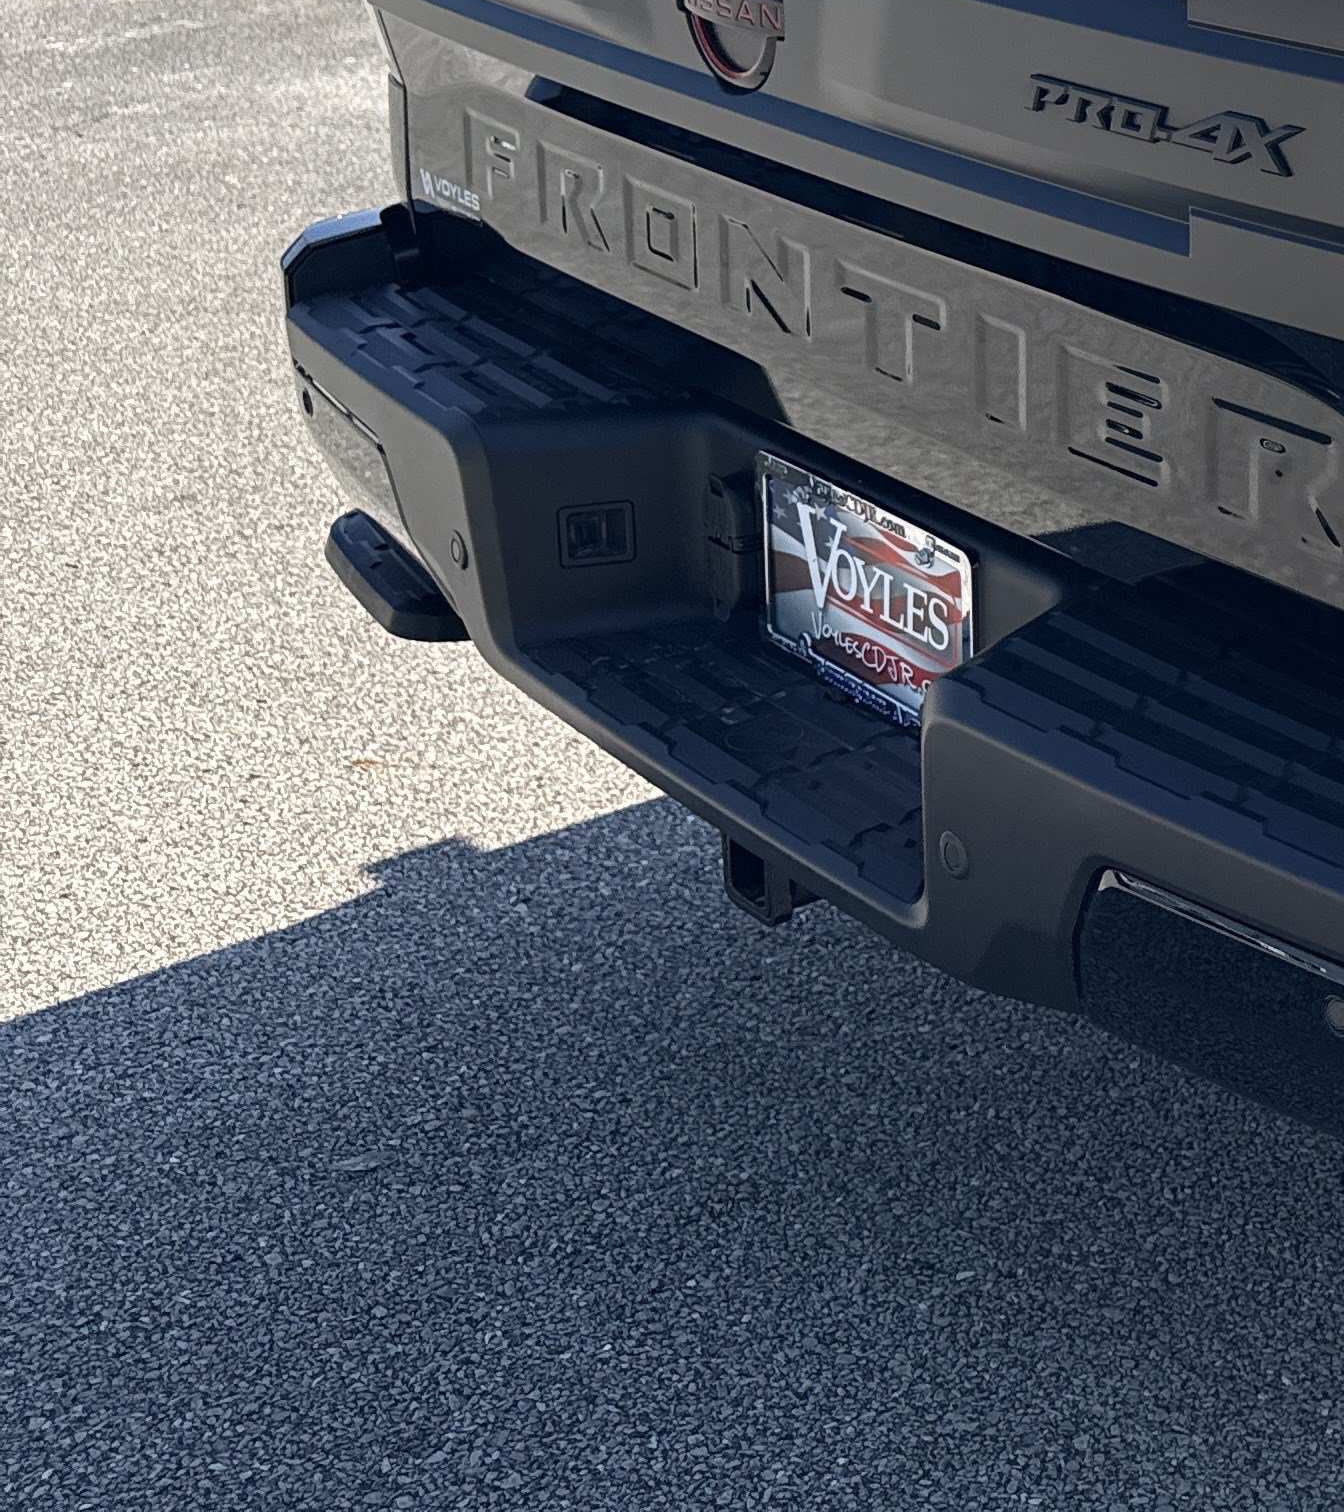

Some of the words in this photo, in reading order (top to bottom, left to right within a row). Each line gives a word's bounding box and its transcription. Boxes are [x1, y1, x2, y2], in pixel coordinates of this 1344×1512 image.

[1025, 72, 1306, 178] PRO-4X
[433, 173, 481, 212] VOYLES
[796, 499, 950, 652] VOYLES
